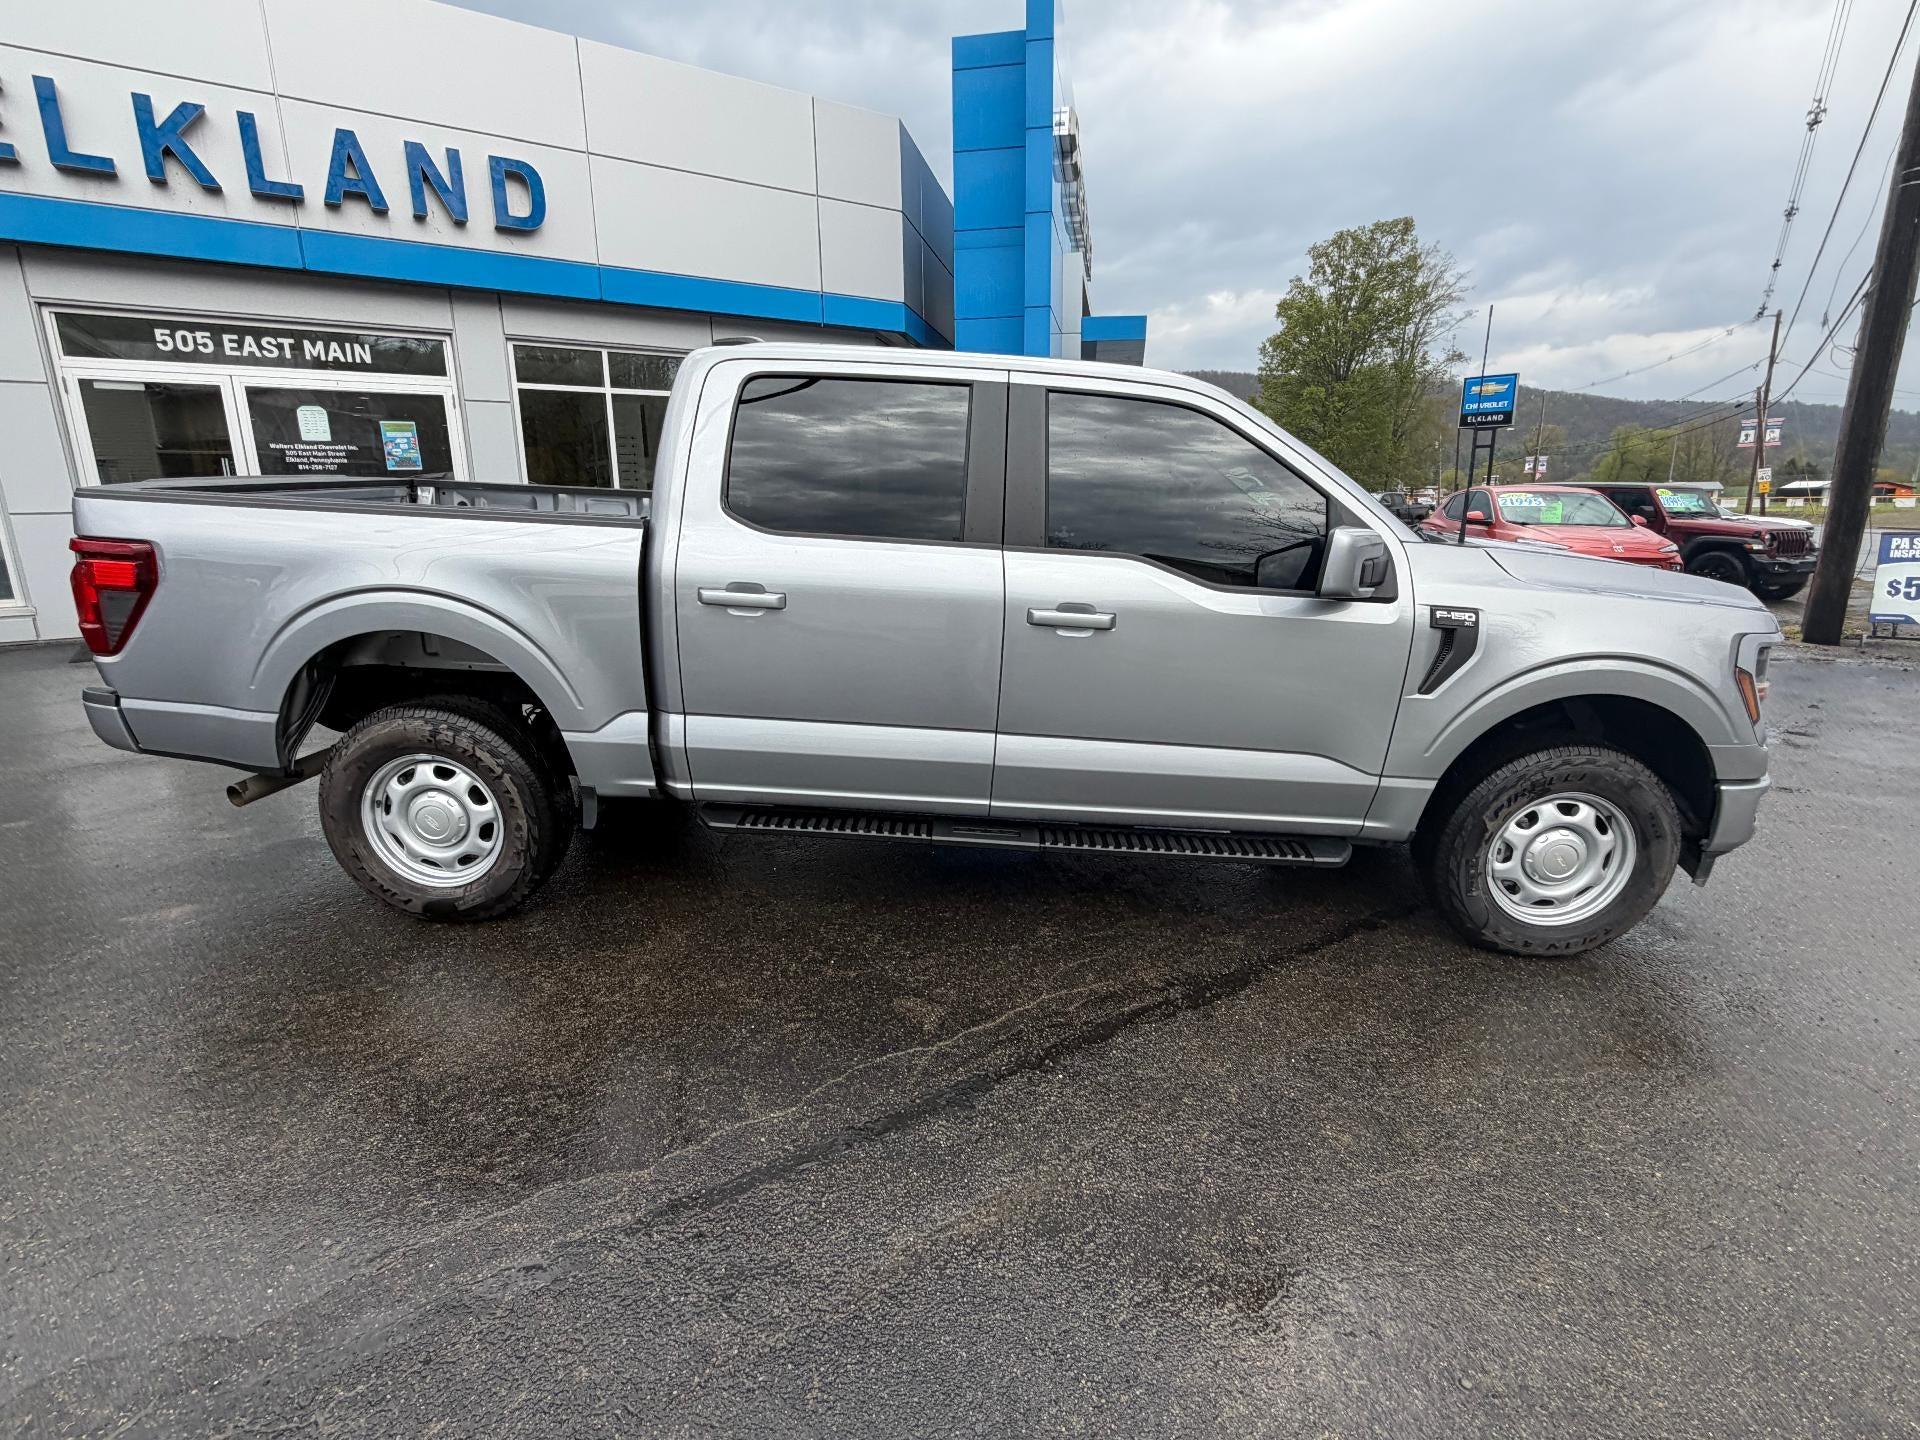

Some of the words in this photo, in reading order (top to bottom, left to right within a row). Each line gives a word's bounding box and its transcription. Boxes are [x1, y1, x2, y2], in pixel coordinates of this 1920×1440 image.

[0, 74, 548, 232] LKLAND
[153, 327, 215, 354] 505
[221, 333, 295, 359] EAST
[302, 339, 373, 364] MAIN
[1467, 414, 1504, 423] ELKLAND
[1501, 497, 1542, 506] 21995
[1891, 537, 1910, 550] PA
[1889, 549, 1920, 558] INSPE
[1436, 610, 1476, 622] F-150
